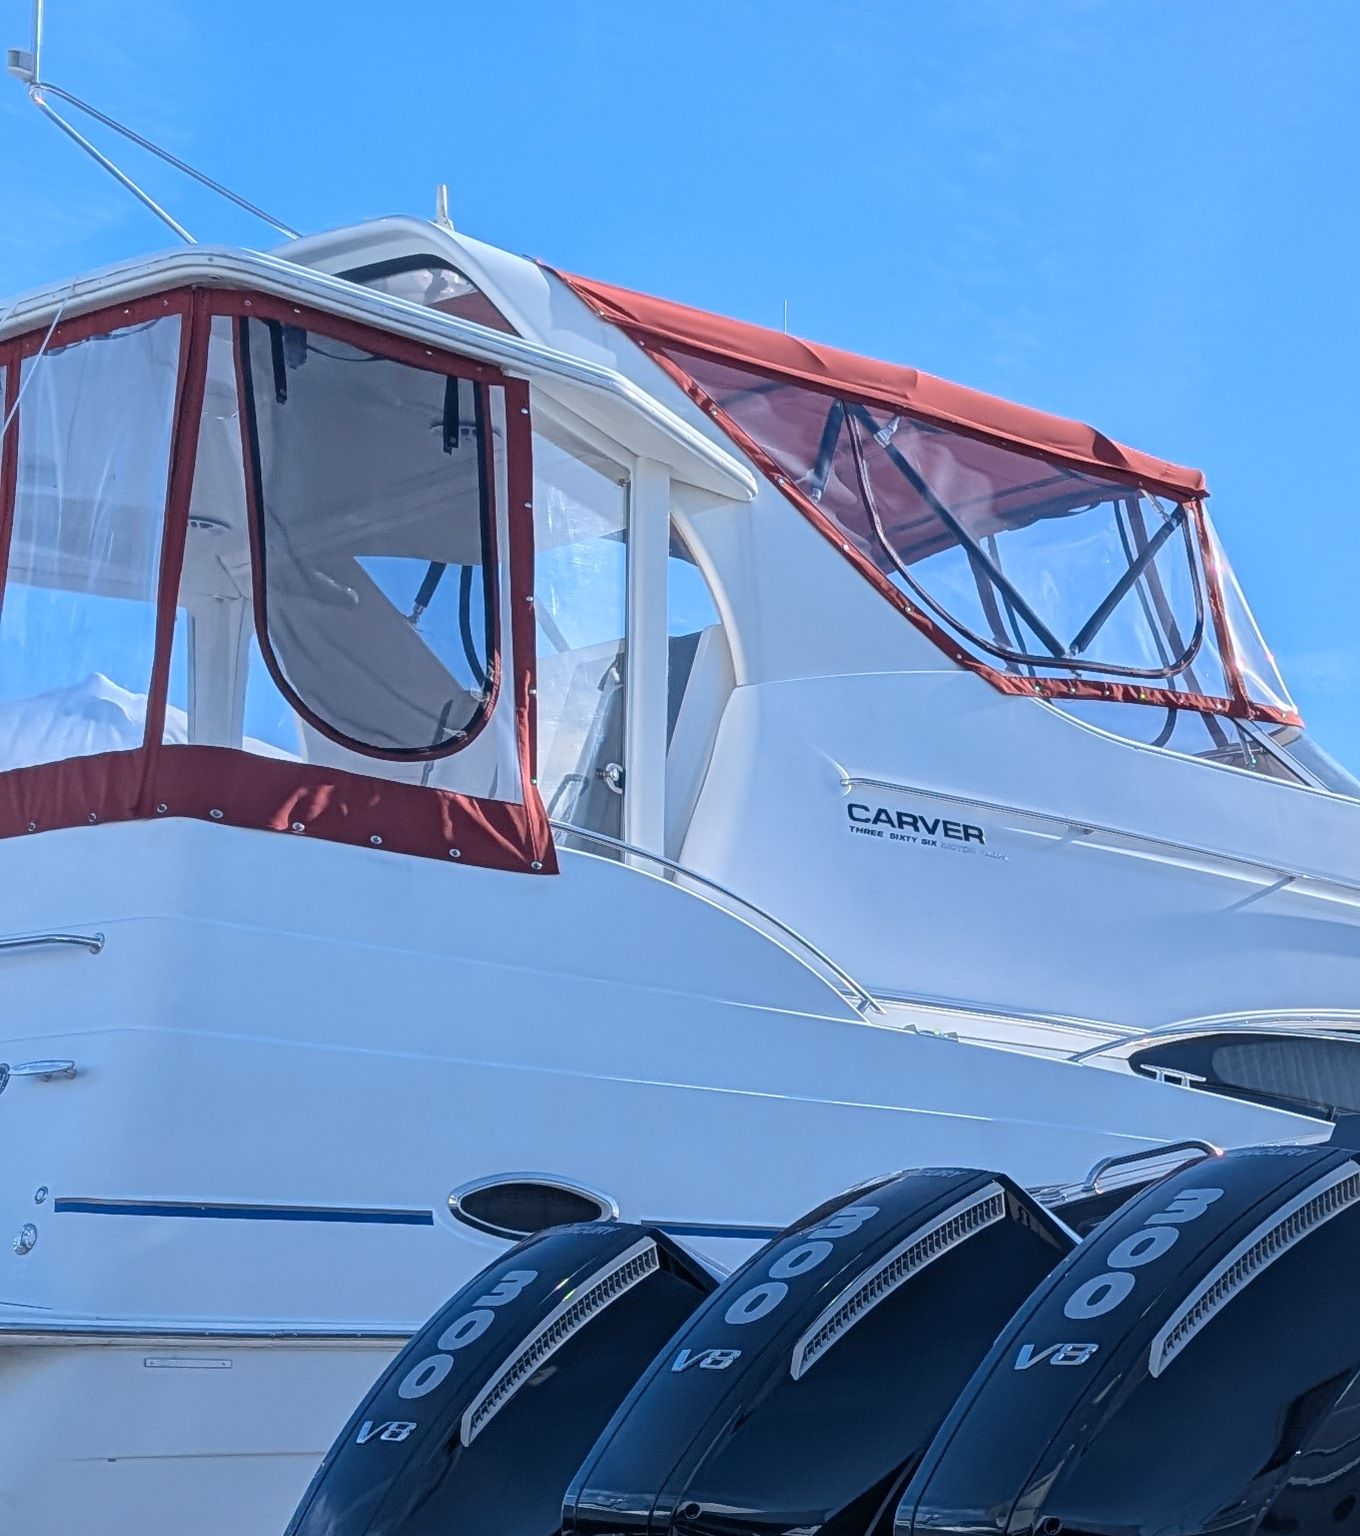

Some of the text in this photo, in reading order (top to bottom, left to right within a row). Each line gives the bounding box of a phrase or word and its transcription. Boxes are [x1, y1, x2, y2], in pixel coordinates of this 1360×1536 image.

[847, 803, 986, 845] CARVER
[849, 825, 884, 837] THREE
[889, 832, 918, 844] SIXTY
[921, 838, 938, 848] SIX
[724, 1206, 880, 1325] 300
[1063, 1188, 1224, 1319] 300
[398, 1270, 538, 1399] 300
[671, 1349, 742, 1372] V8
[1014, 1343, 1099, 1370] V8
[356, 1420, 417, 1444] V8
